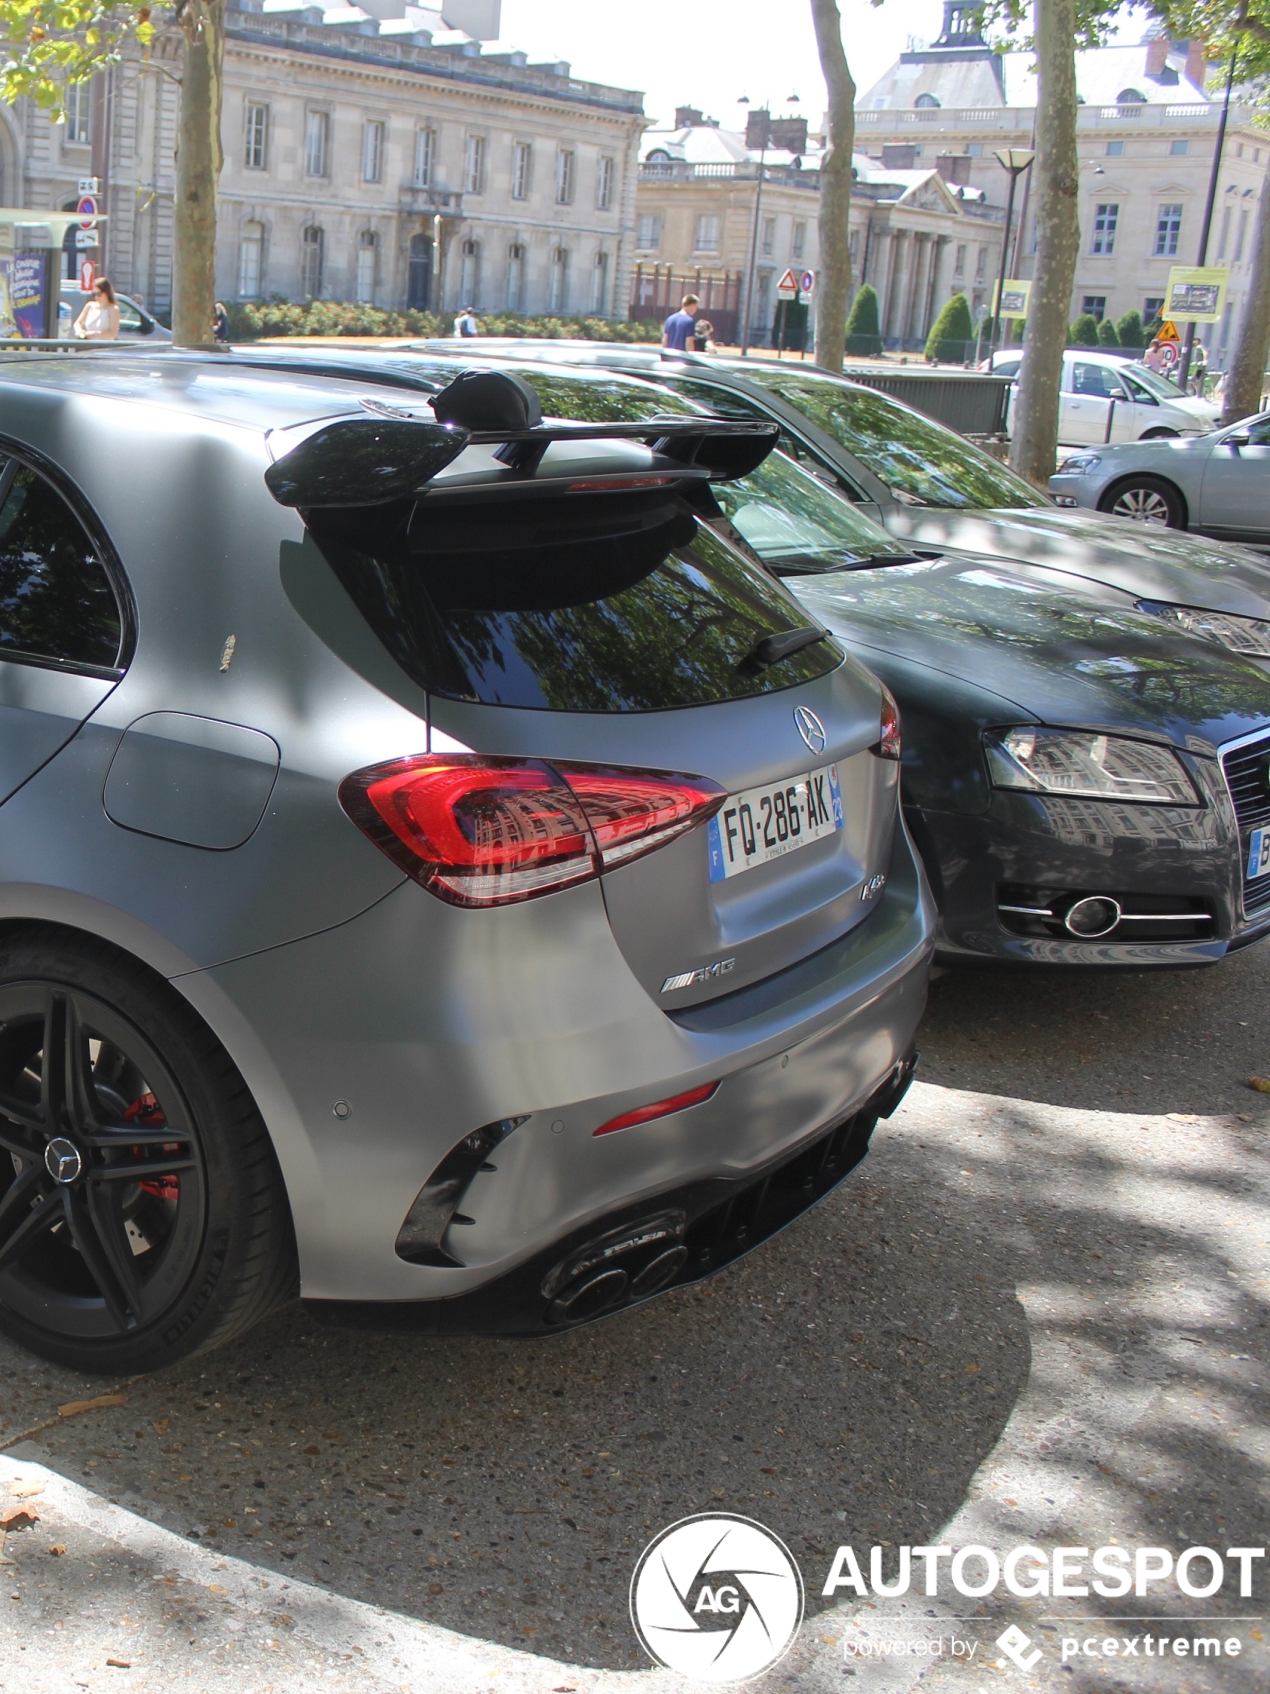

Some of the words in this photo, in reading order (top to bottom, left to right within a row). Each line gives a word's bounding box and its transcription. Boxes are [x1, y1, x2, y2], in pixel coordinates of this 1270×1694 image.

[723, 774, 830, 863] FQ-286-AK
[832, 796, 844, 822] 23
[690, 957, 736, 982] AMG
